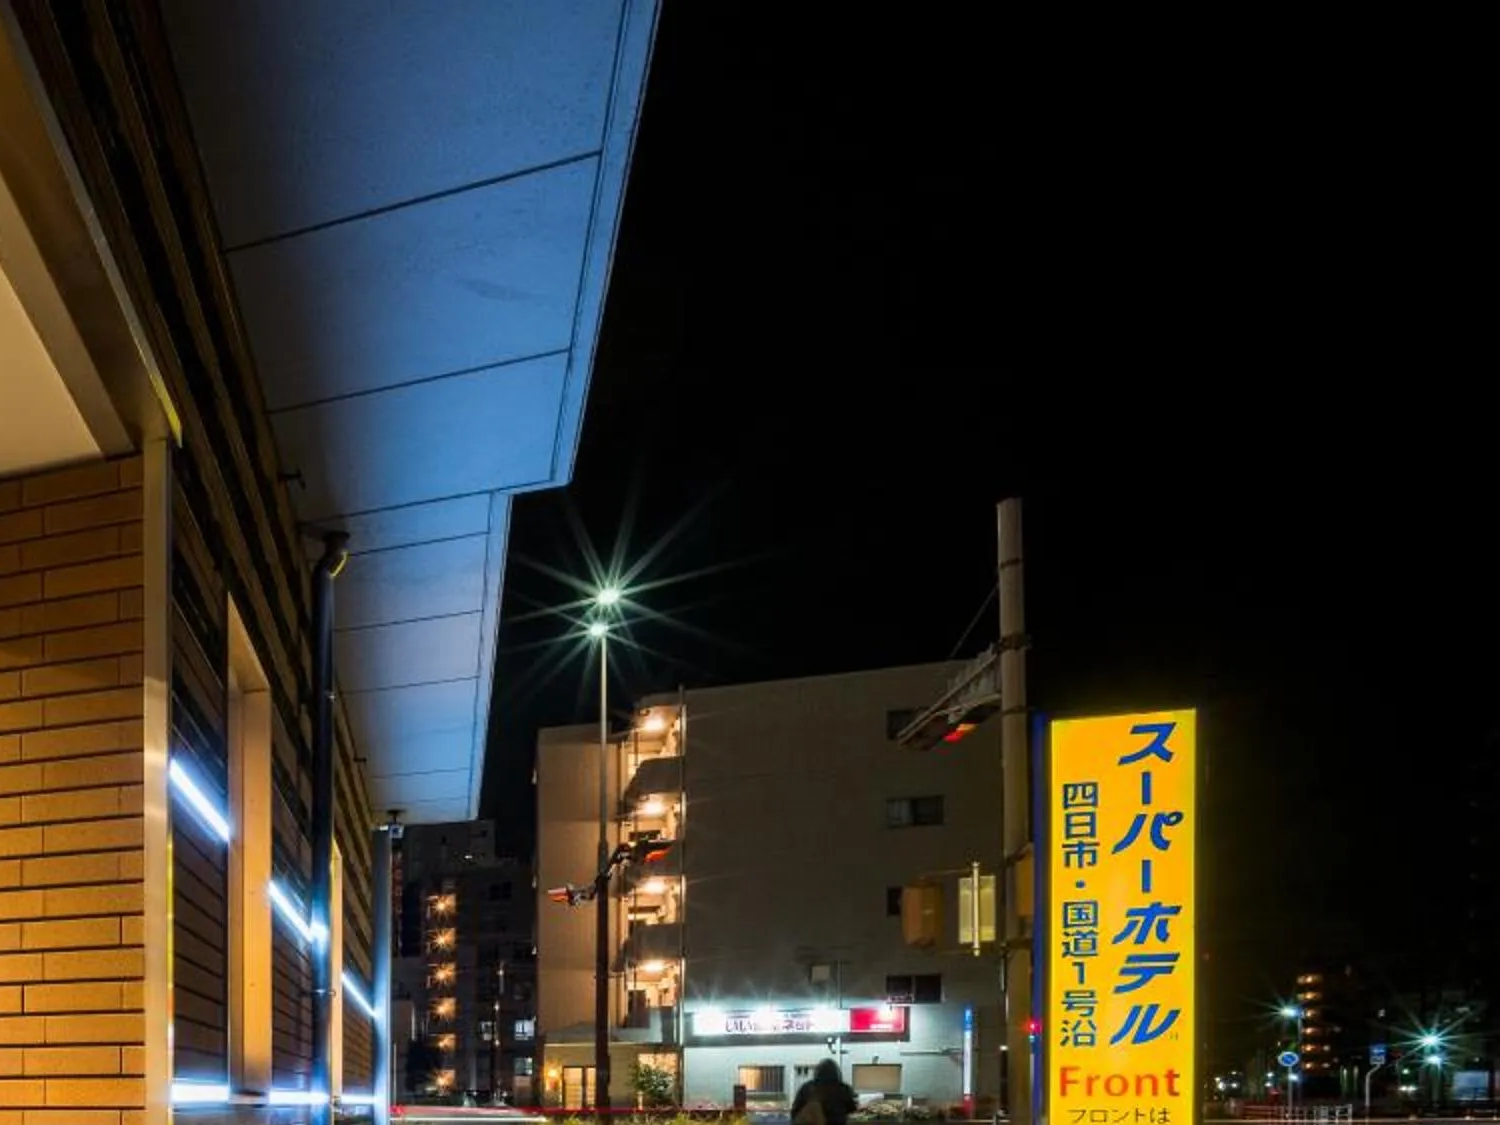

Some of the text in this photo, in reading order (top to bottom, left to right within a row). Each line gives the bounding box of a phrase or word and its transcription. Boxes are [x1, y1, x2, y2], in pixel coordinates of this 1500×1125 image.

[1060, 781, 1101, 1048] 四日市・国道1号沿
[1110, 721, 1184, 1045] スーパーホテル
[1059, 1066, 1181, 1098] Front
[1068, 1106, 1172, 1125] フロントは
